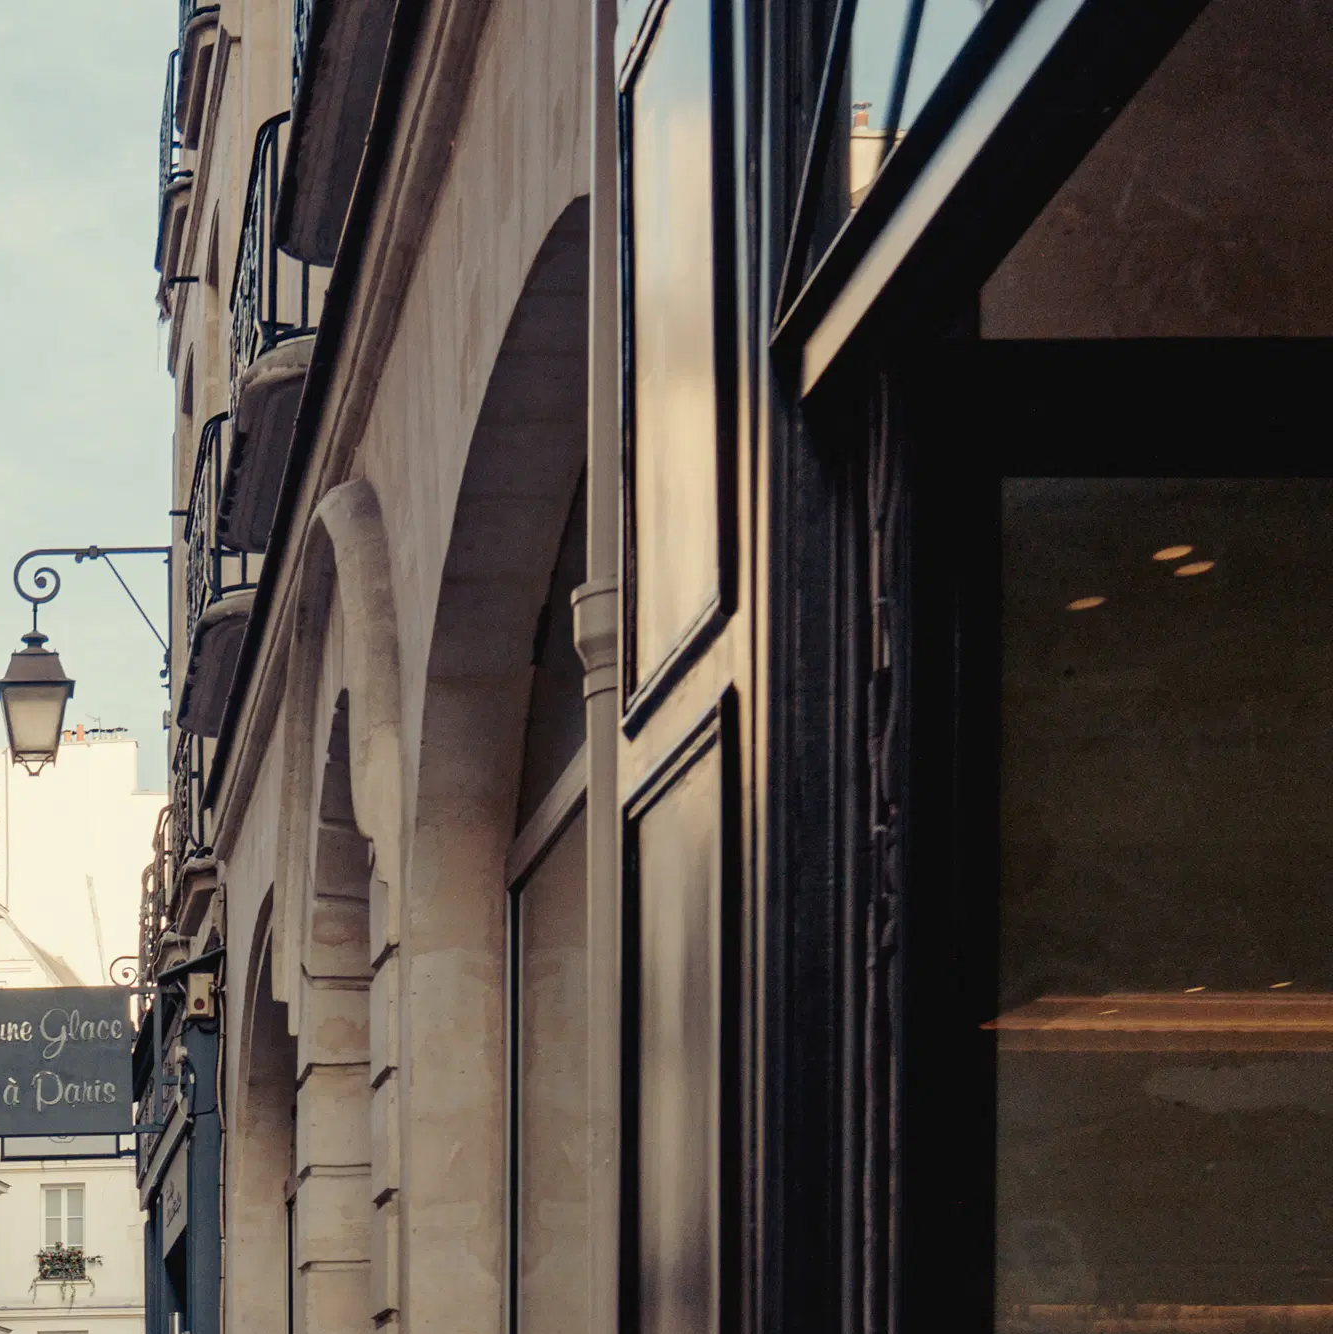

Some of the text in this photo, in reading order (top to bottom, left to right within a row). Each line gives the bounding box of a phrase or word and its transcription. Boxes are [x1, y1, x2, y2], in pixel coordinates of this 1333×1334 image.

[39, 1008, 123, 1060] Glace
[3, 1070, 116, 1113] à Paris
